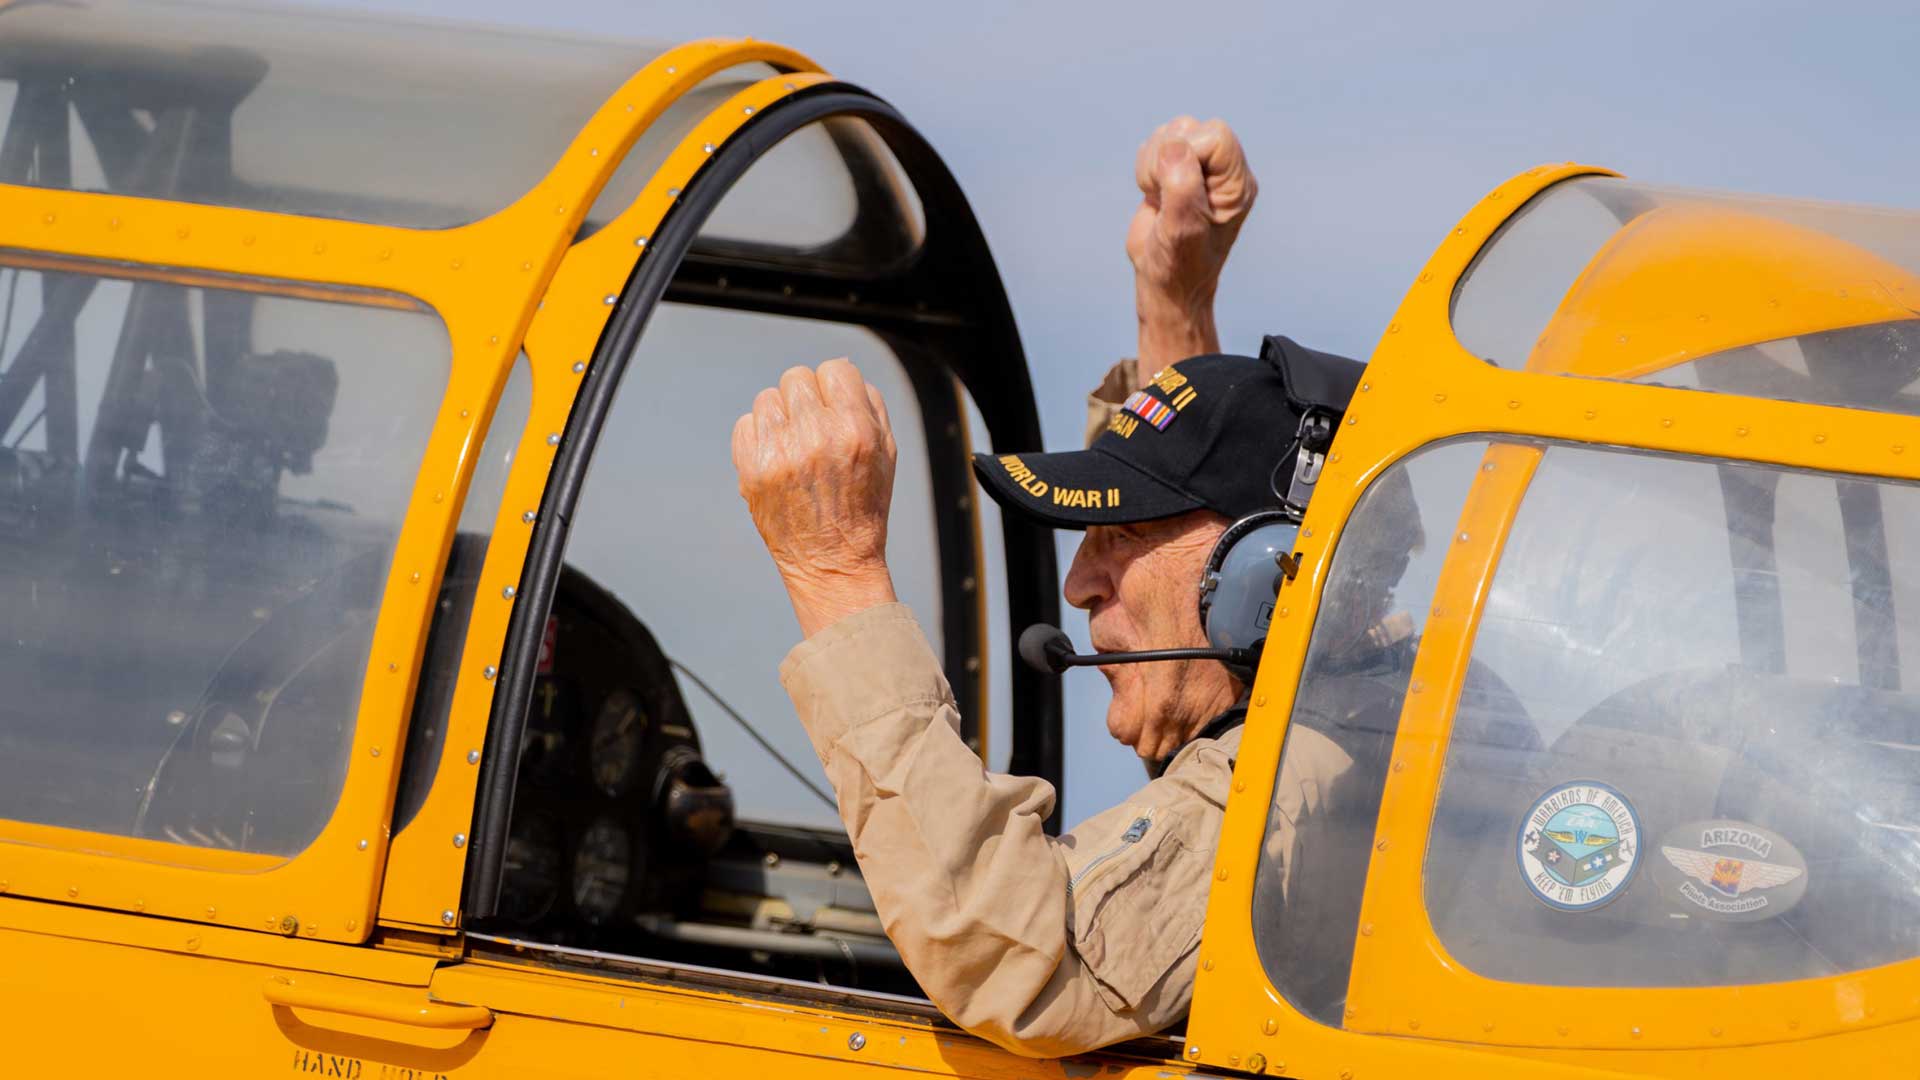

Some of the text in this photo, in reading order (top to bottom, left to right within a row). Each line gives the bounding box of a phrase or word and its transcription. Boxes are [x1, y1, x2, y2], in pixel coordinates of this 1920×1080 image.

[1172, 386, 1197, 411] II
[1000, 455, 1120, 508] WORLD WAR II
[1532, 789, 1634, 835] WARBIRDS OF AMERICA
[1703, 830, 1771, 855] ARIZONA
[1534, 871, 1556, 893] KEEP
[1580, 878, 1613, 901] FLYING
[1682, 883, 1767, 912] Pilots Association
[293, 1050, 362, 1080] HAND
